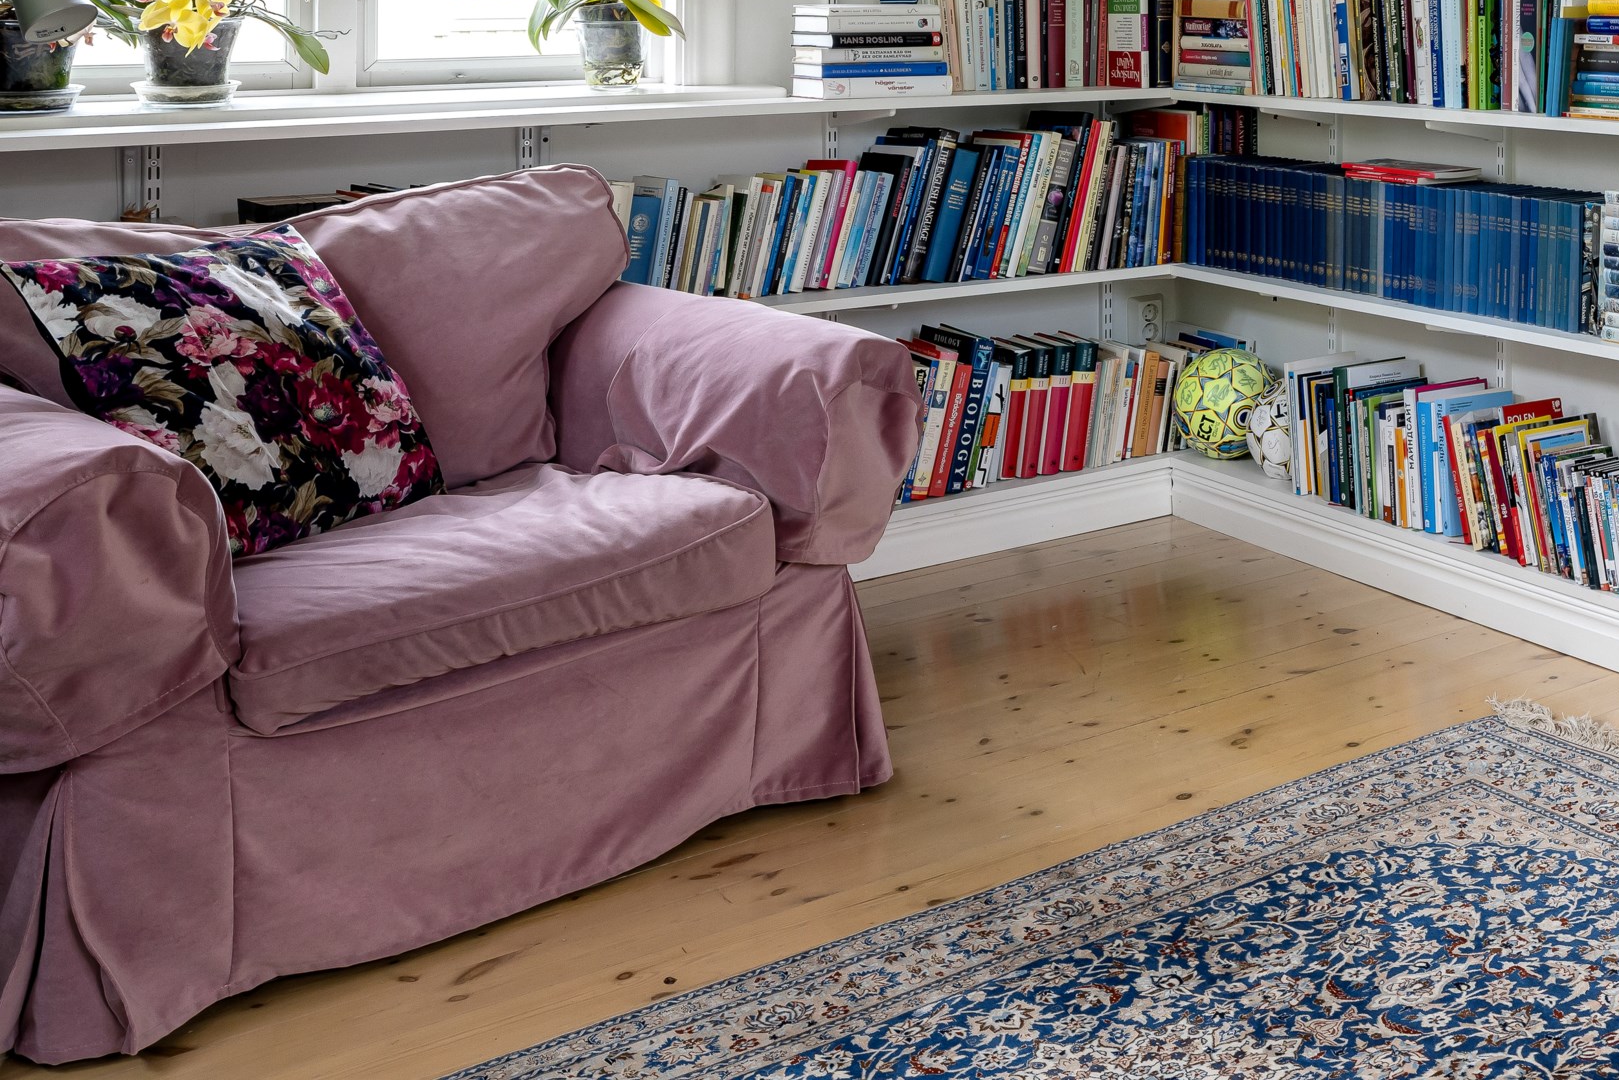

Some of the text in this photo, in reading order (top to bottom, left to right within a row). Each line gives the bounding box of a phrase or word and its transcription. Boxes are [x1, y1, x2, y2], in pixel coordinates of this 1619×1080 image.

[840, 35, 904, 44] HANS ROSLING
[920, 150, 949, 241] THE ENGLISH LANGUAGE
[934, 332, 960, 348] BIOLOGY
[952, 377, 984, 477] BIOLOGY
[1546, 476, 1554, 502] Ukraine
